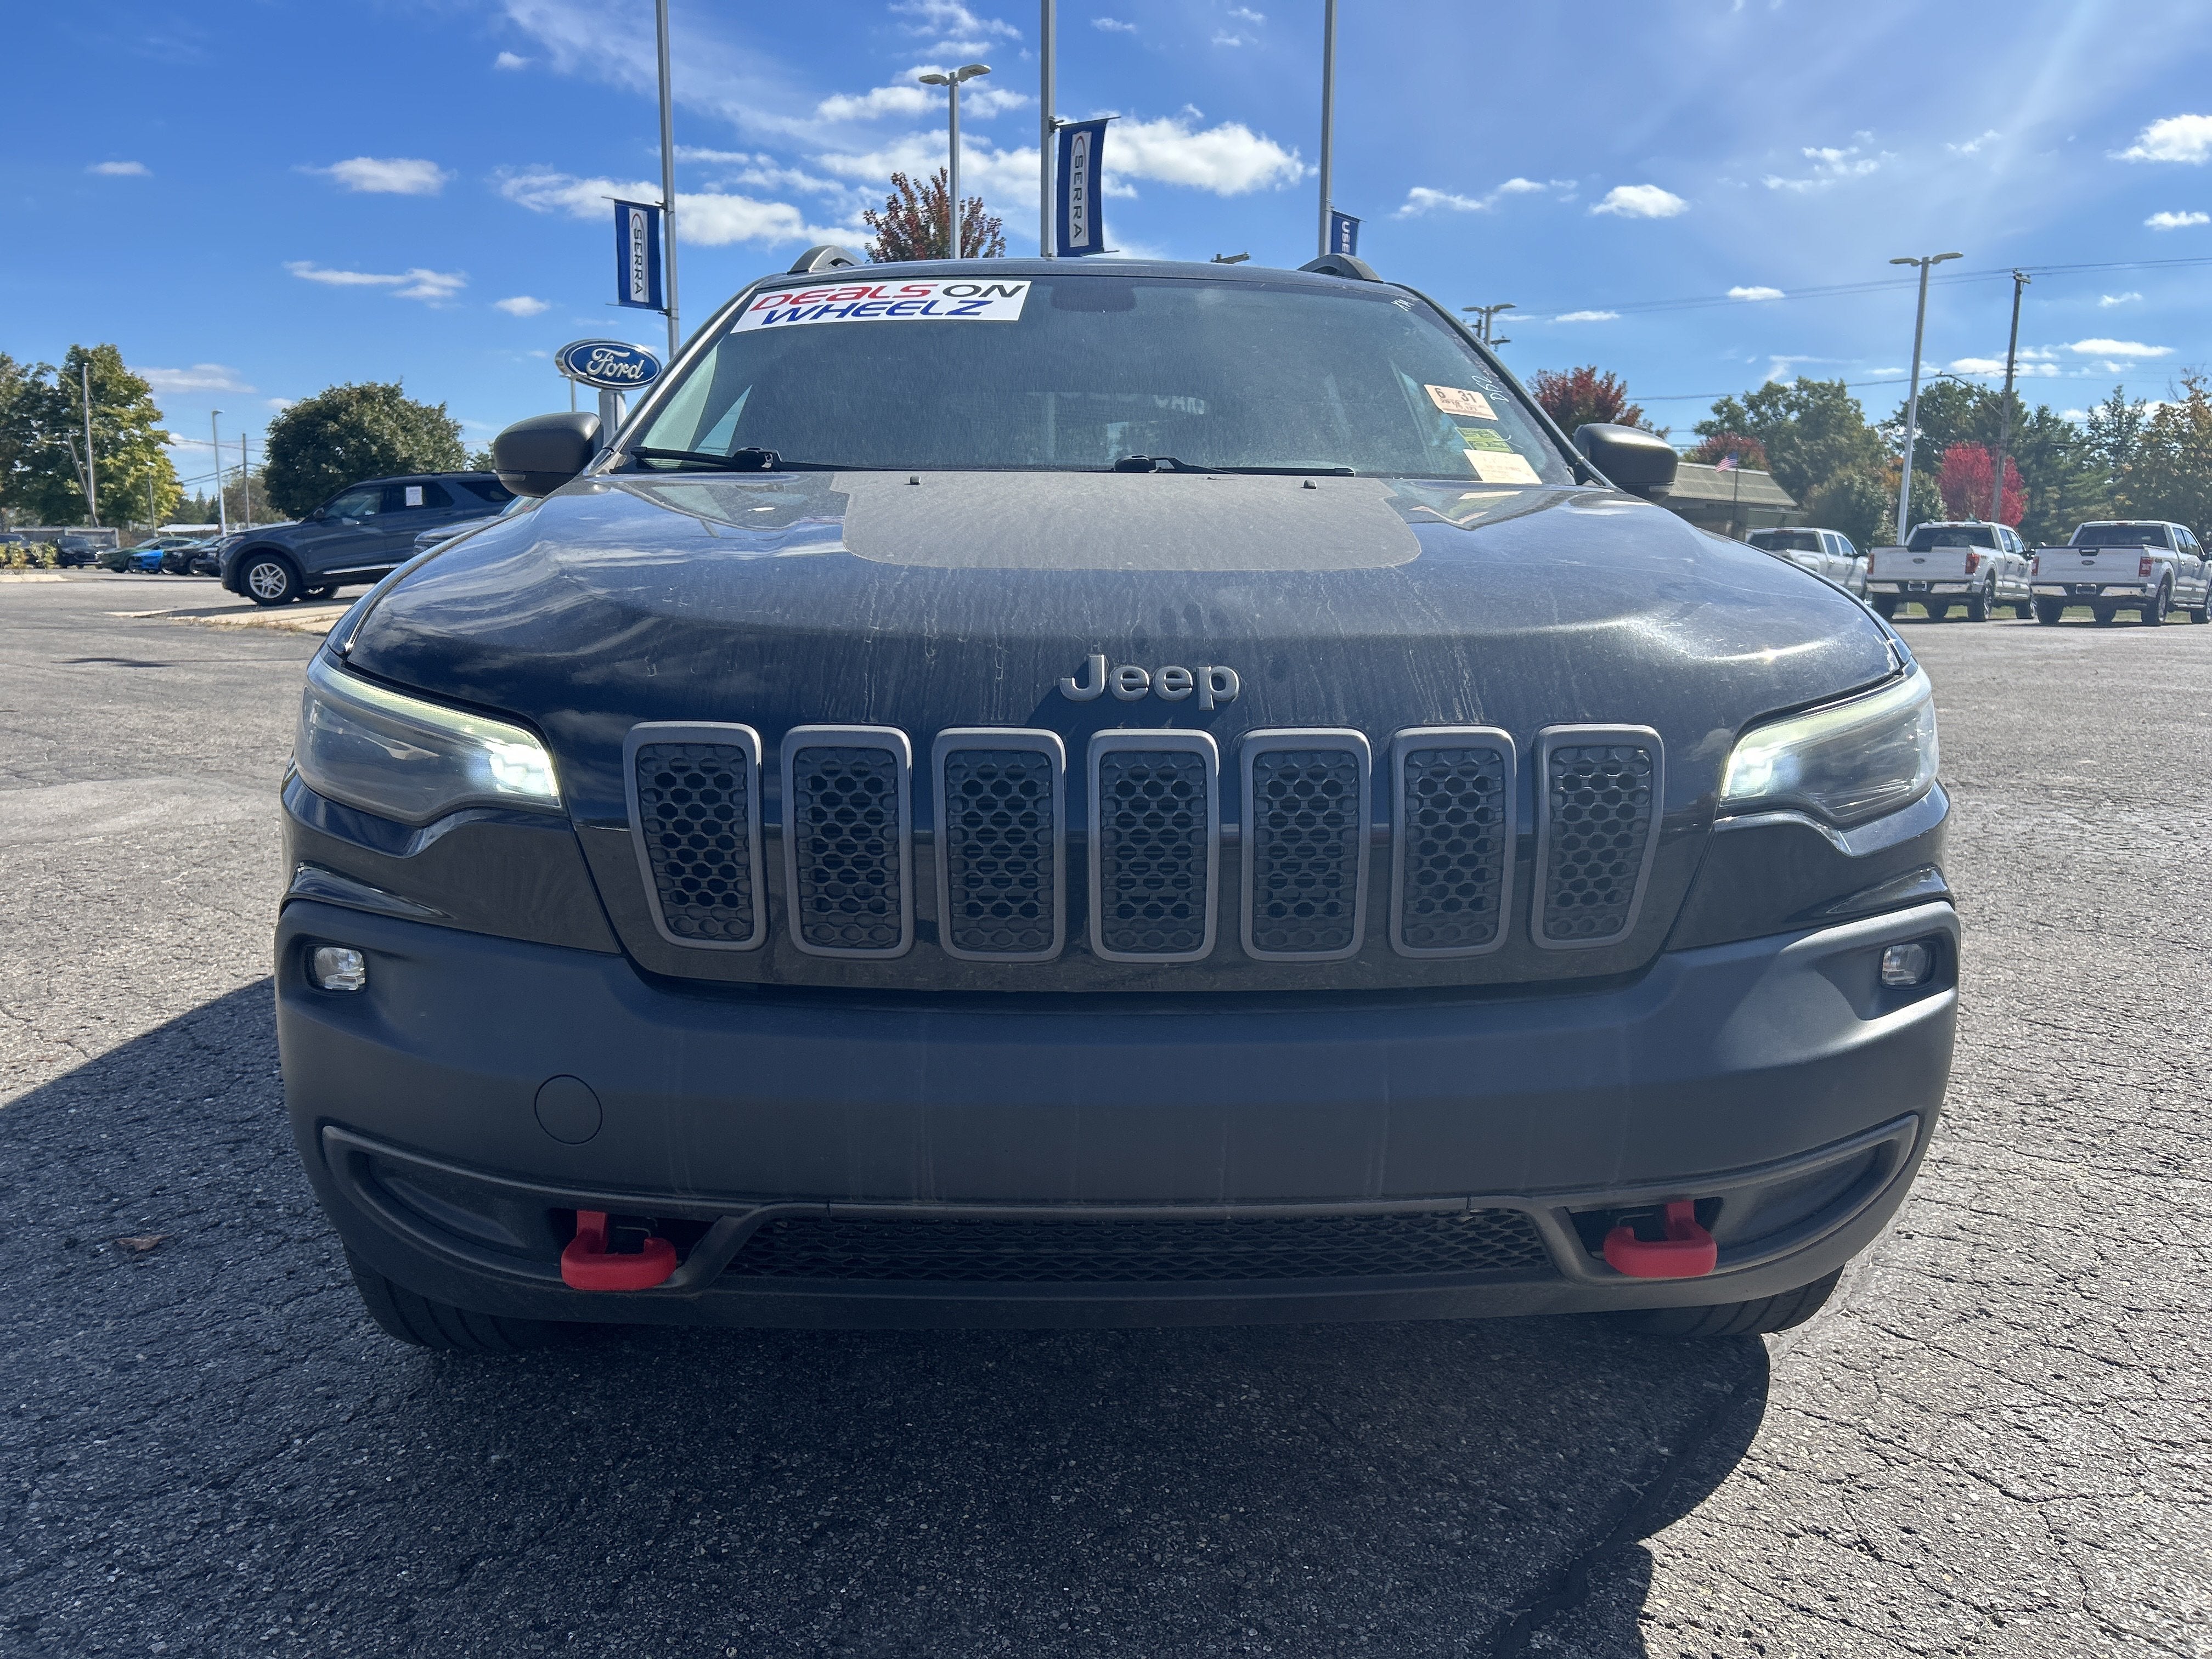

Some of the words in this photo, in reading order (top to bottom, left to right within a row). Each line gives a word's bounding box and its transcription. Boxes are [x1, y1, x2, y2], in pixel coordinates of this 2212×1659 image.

[1073, 155, 1084, 239] SERRA
[1341, 221, 1350, 253] USE
[633, 228, 644, 295] SERRA
[942, 284, 1026, 298] ON
[761, 300, 994, 326] WHEELZ
[585, 347, 645, 380] Ford
[1435, 387, 1446, 398] 6
[1458, 391, 1477, 403] 31
[1059, 653, 1240, 712] Jeep
